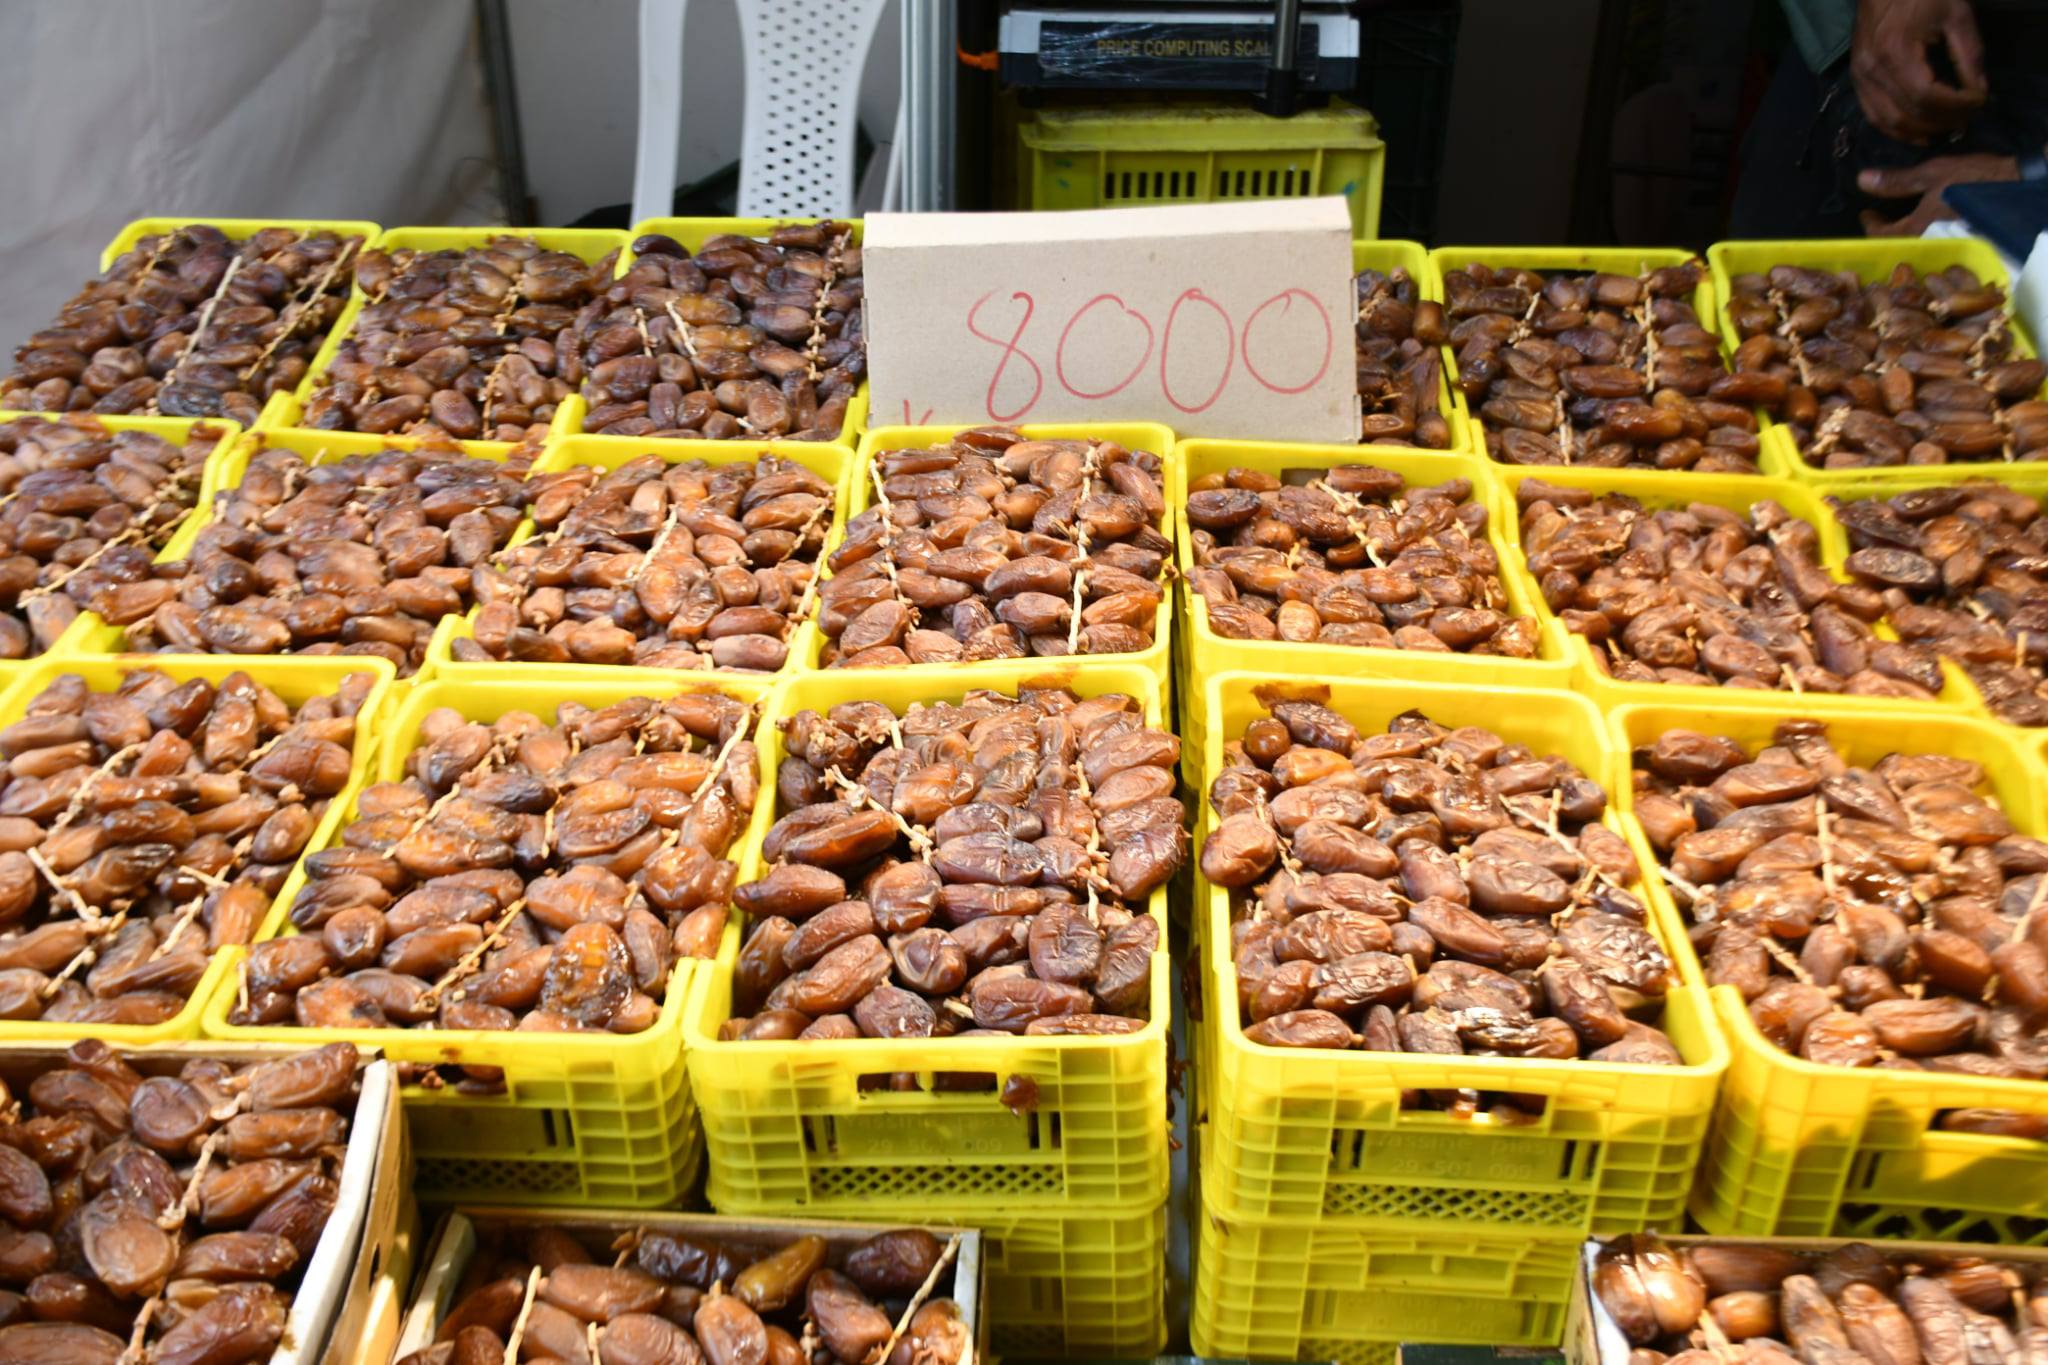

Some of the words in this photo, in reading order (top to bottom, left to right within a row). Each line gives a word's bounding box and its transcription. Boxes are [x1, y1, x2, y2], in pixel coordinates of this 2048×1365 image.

[1098, 40, 1139, 57] PRICE
[1144, 40, 1229, 57] COMPUTING
[1234, 40, 1272, 57] SCAL
[967, 287, 1332, 422] 8000
